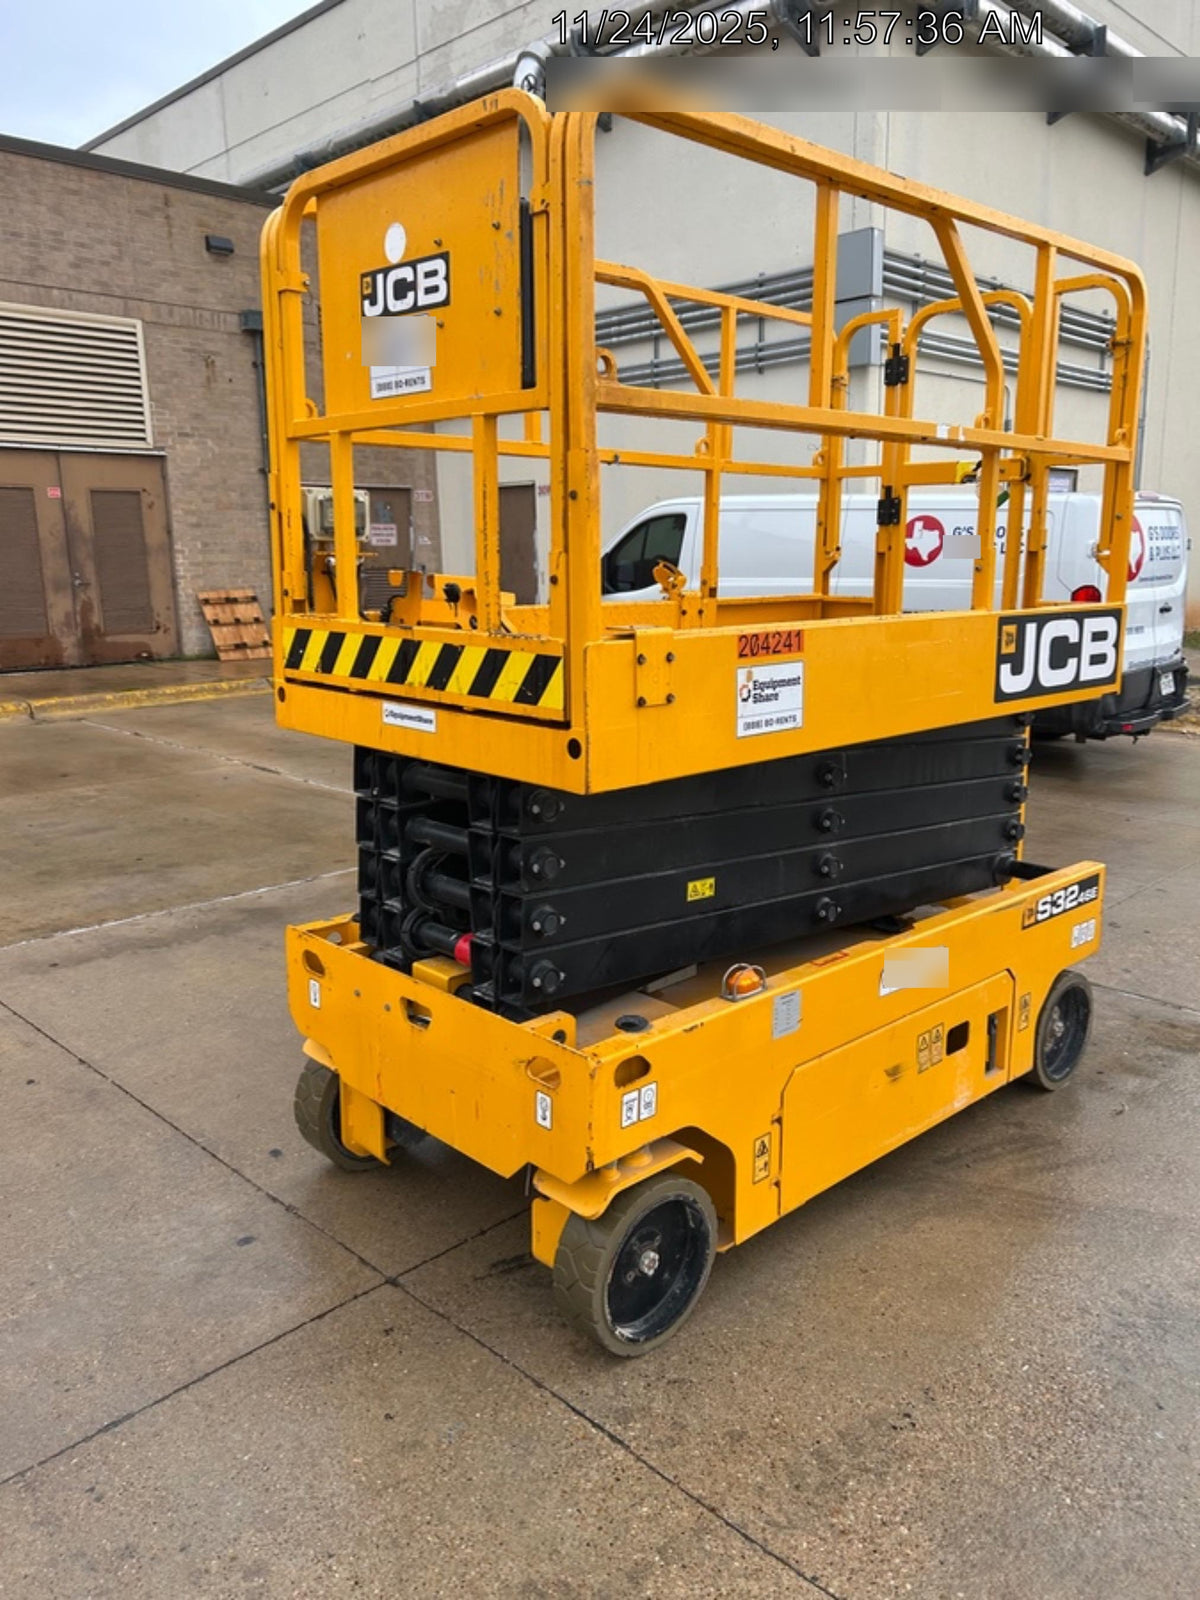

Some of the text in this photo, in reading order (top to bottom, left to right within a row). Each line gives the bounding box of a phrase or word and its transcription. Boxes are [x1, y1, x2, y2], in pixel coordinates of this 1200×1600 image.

[363, 258, 449, 317] JCB
[738, 629, 802, 658] 204241
[1000, 616, 1119, 694] JCB
[752, 675, 801, 692] Equipment
[752, 692, 780, 704] Share
